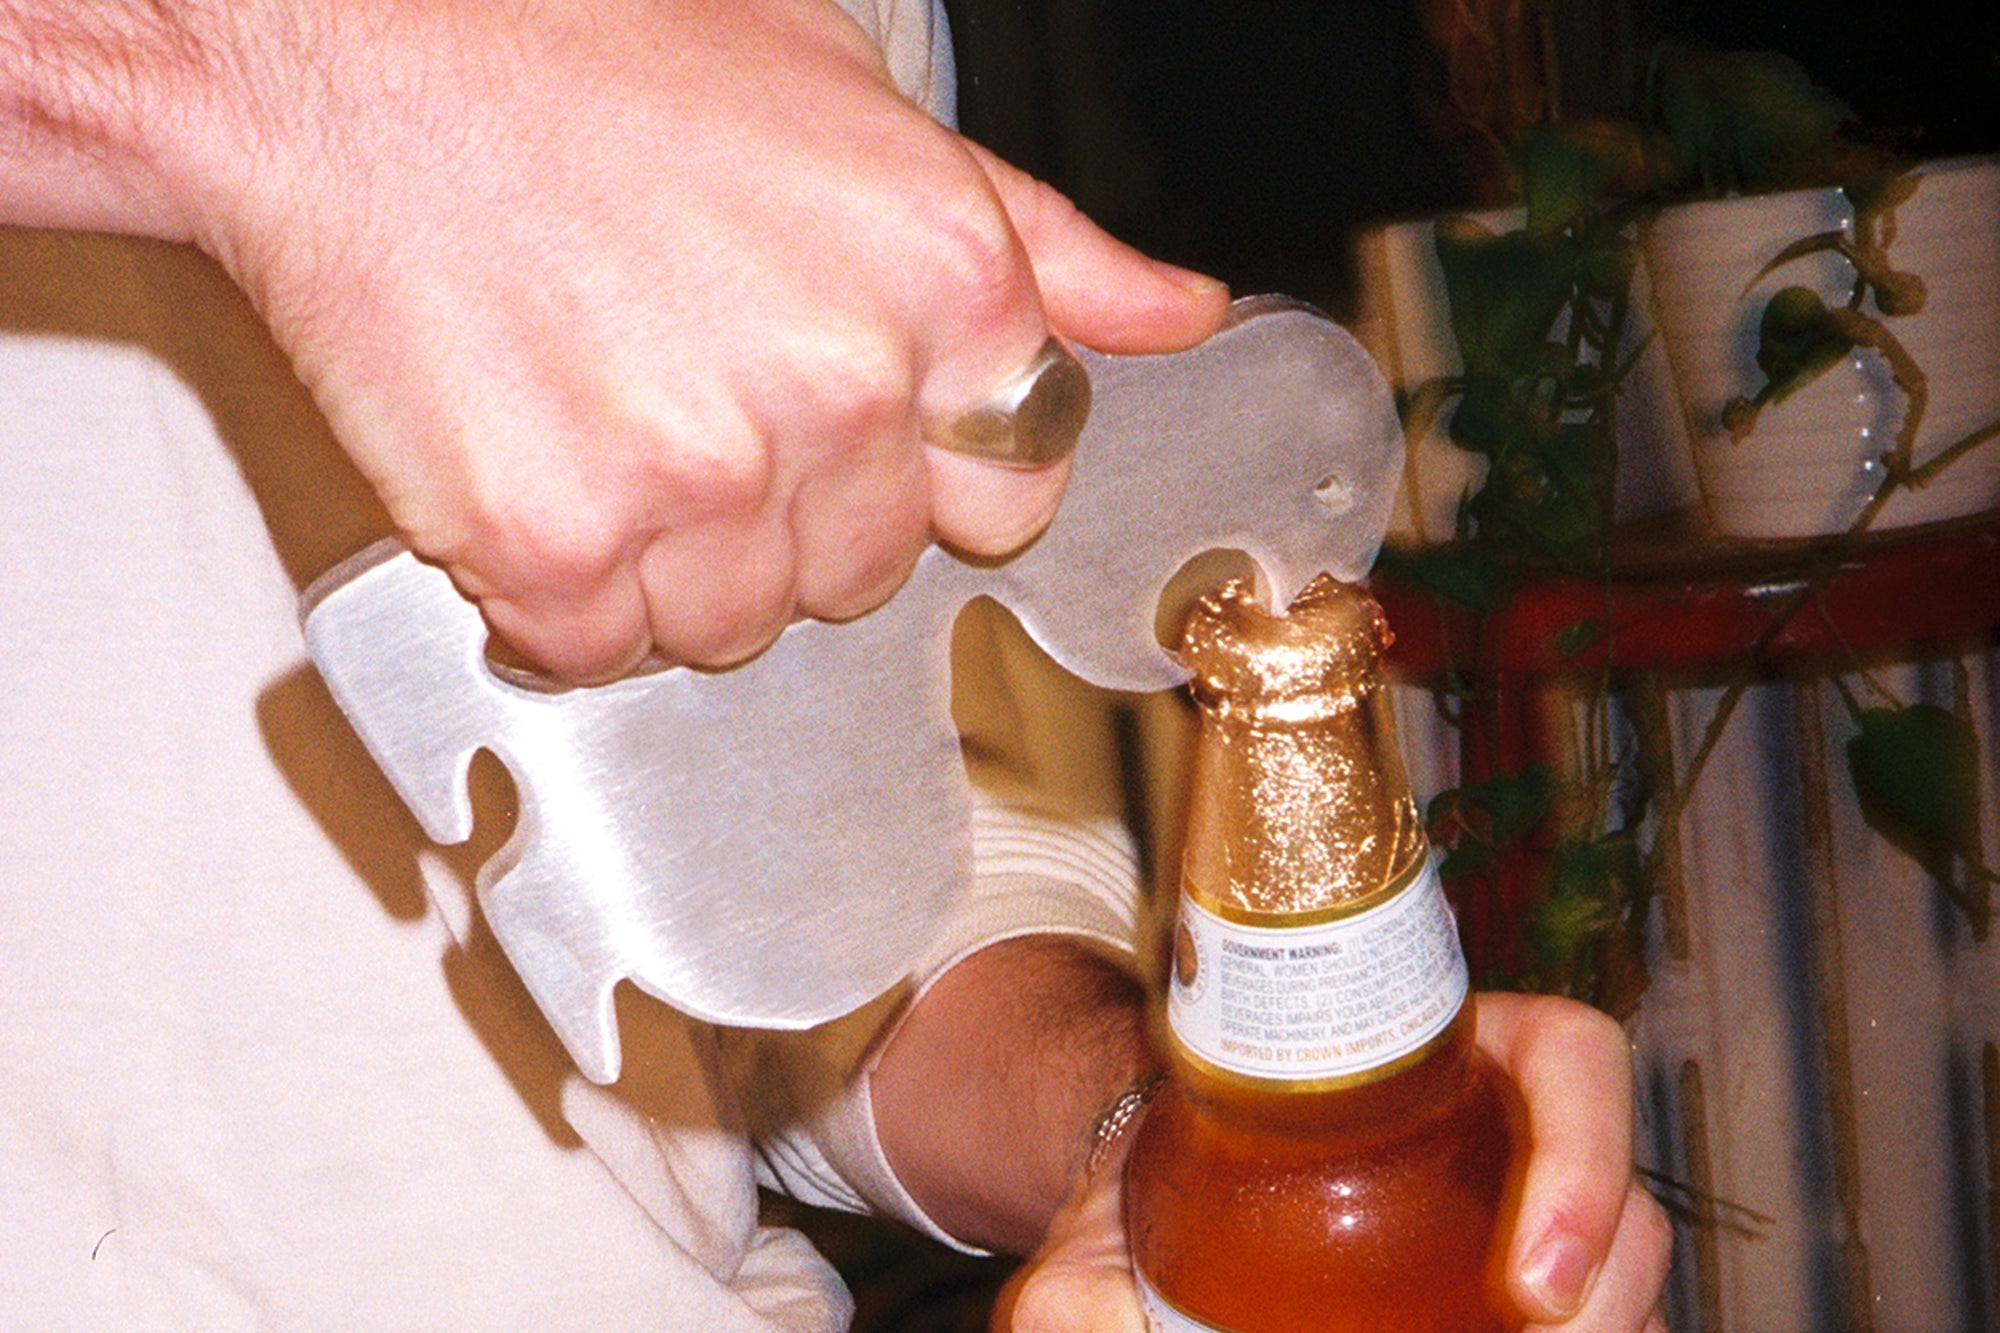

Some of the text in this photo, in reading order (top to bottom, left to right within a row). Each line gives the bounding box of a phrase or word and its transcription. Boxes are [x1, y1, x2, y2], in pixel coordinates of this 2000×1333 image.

[1221, 938, 1286, 961] GOVERNMENT
[1274, 962, 1319, 978] WOMEN
[1321, 949, 1368, 974] SHOULD
[1369, 938, 1390, 958] NOT
[1220, 970, 1274, 994] BEVERAGES
[1276, 978, 1317, 994] DURING
[1318, 963, 1378, 990] PREGNANCY
[1334, 964, 1416, 1005] CONSUMPTION
[1220, 1001, 1283, 1026] BEVERAGES
[1334, 1001, 1367, 1019] YOUR
[1330, 1021, 1353, 1038] AND
[1353, 1014, 1376, 1031] MAY
[1376, 998, 1409, 1025] CAUSE
[1276, 1047, 1291, 1061] BY
[1296, 1044, 1342, 1062] CROWN
